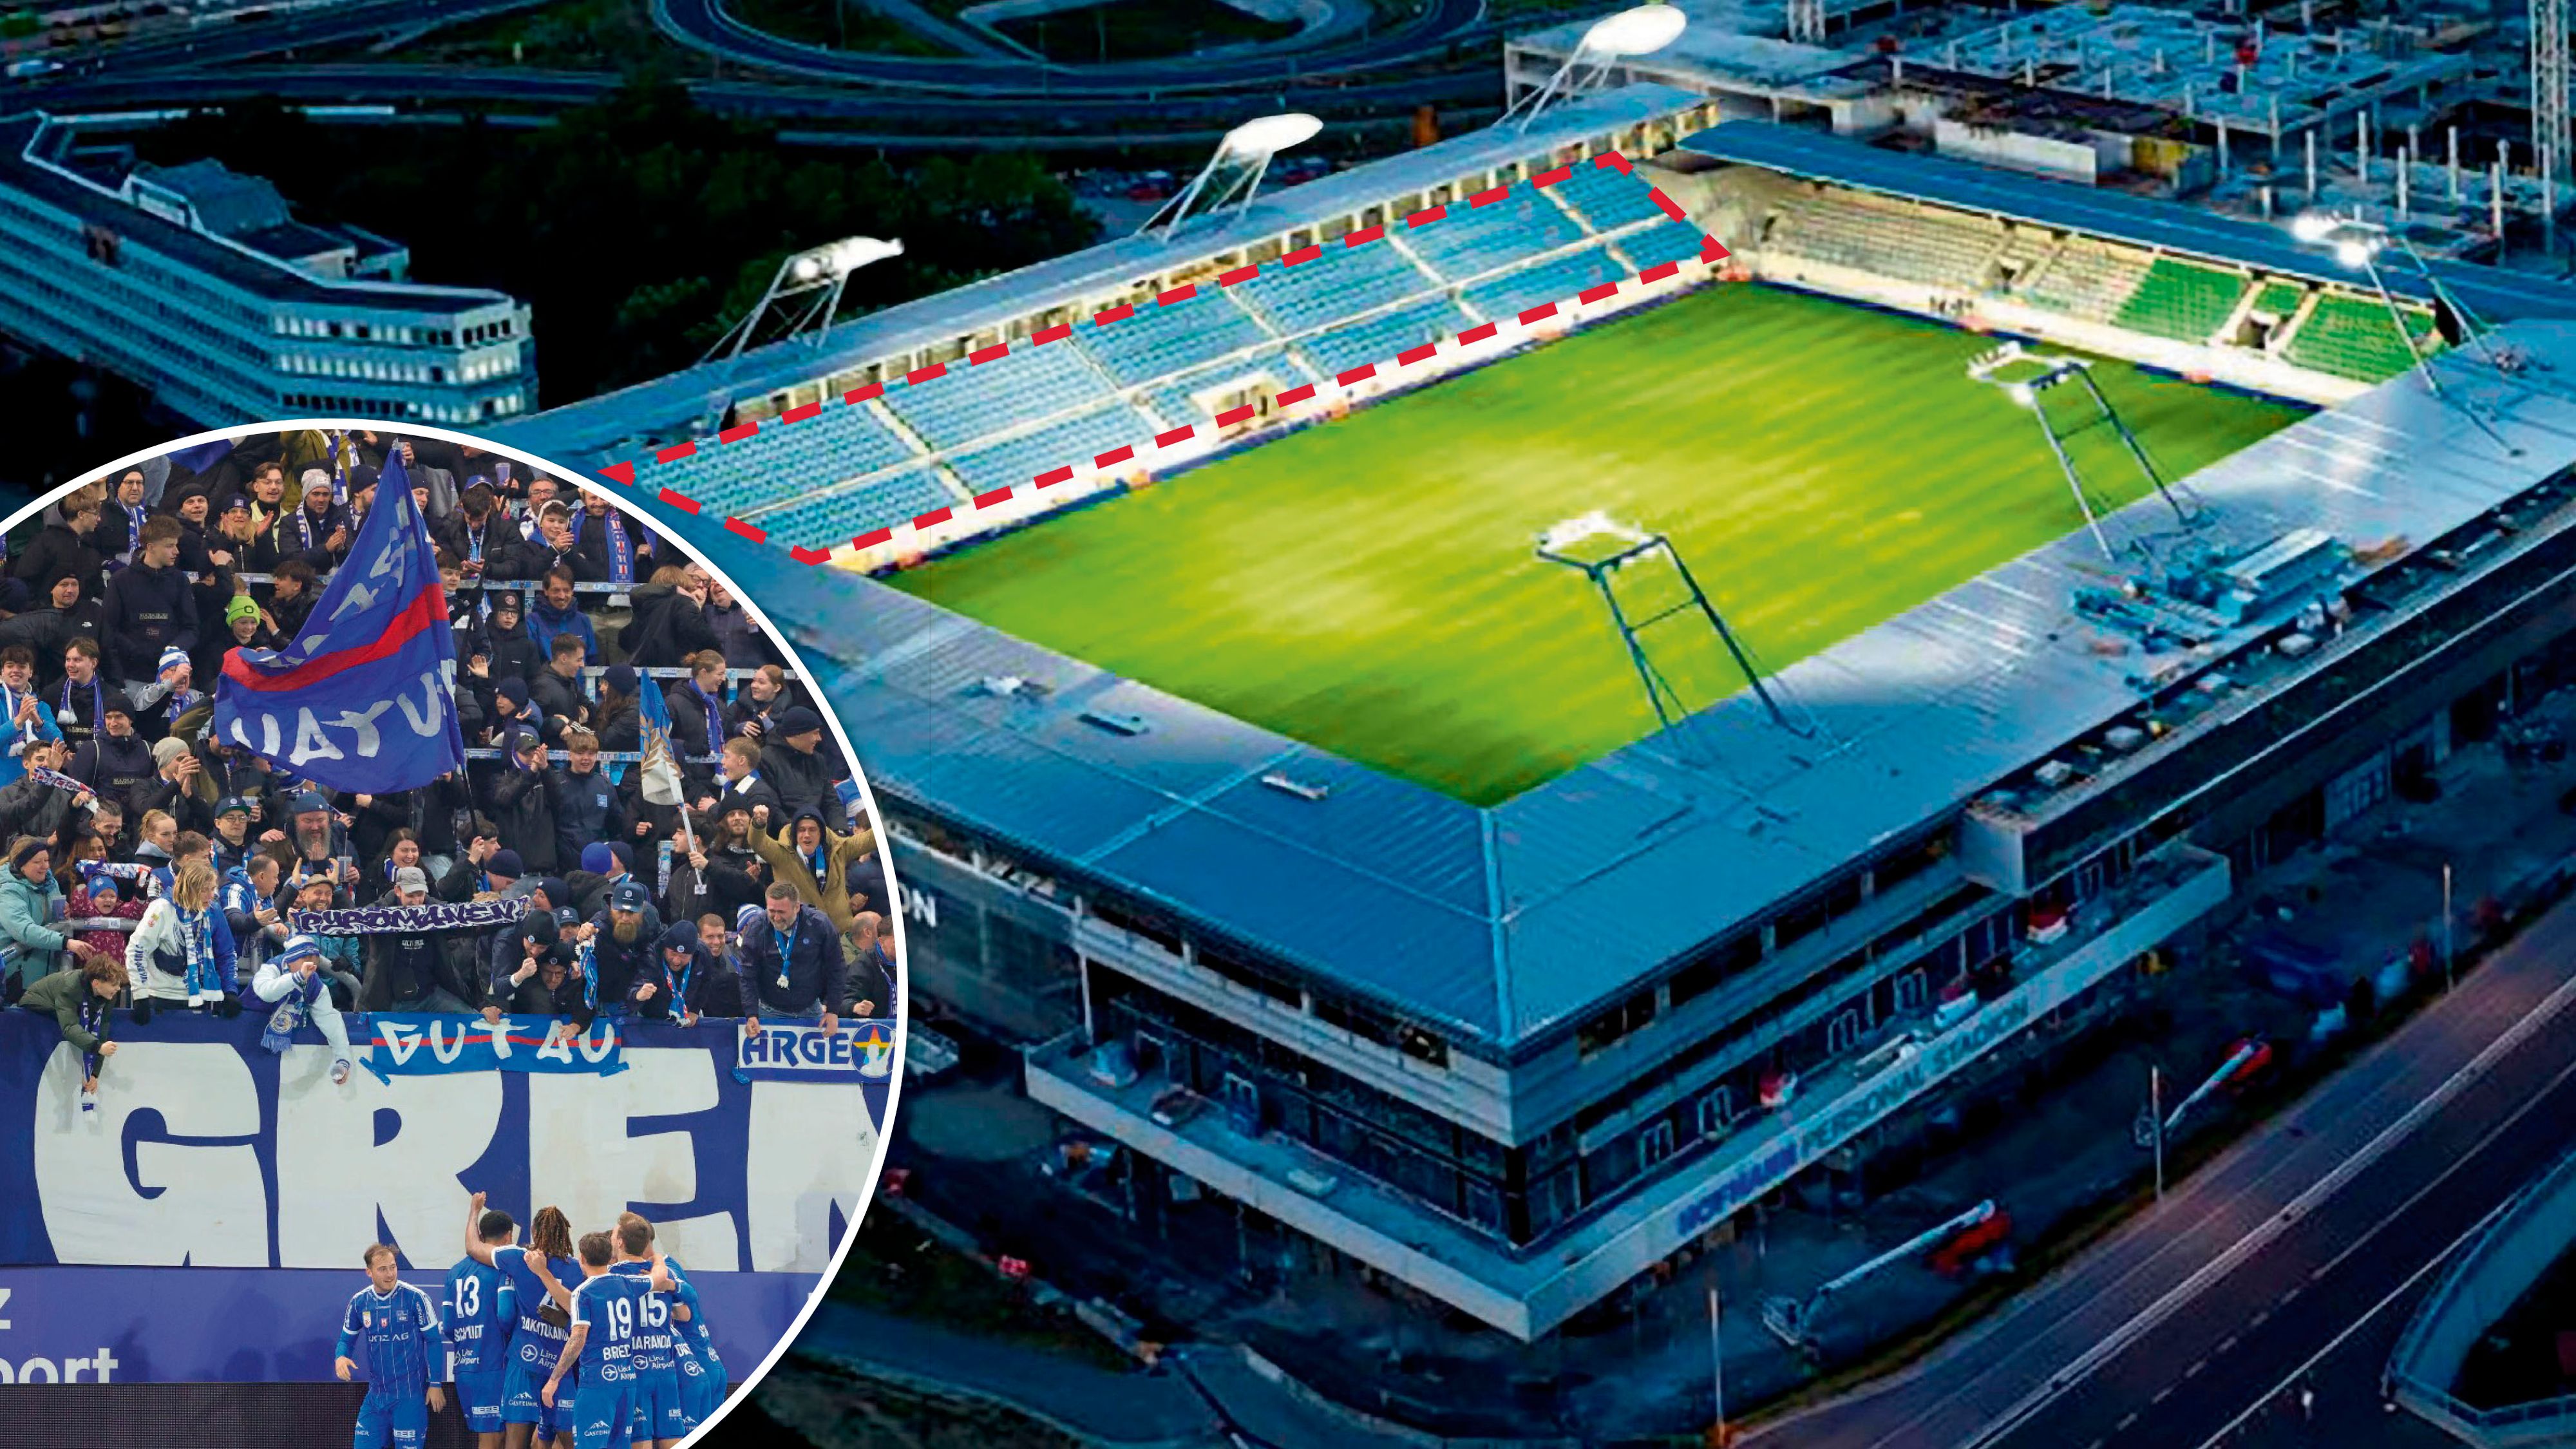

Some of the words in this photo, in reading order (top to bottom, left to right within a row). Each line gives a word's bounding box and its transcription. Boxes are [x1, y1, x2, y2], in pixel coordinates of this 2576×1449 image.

[377, 1018, 615, 1066] GUTAU
[455, 1275, 480, 1318] 13
[639, 1291, 667, 1327] 15
[607, 1297, 631, 1341] 19
[537, 1358, 556, 1370] Airp
[540, 1349, 558, 1360] Linz
